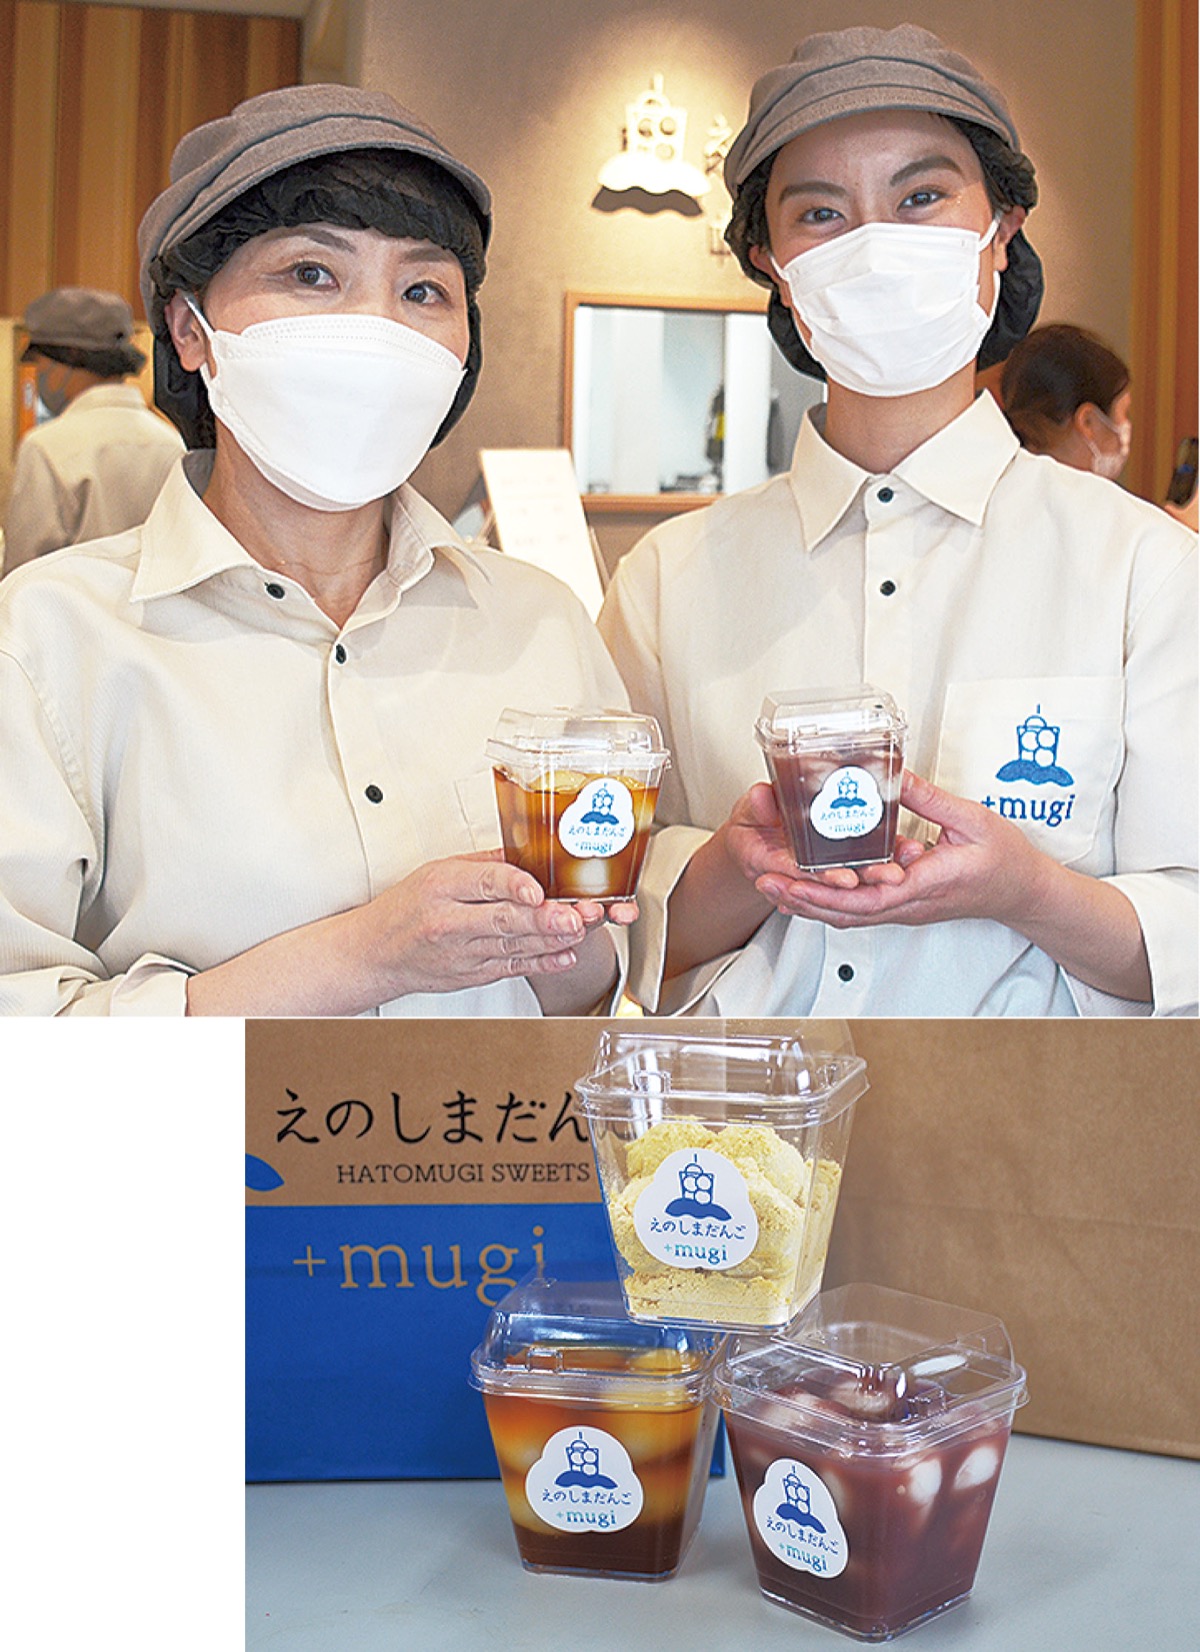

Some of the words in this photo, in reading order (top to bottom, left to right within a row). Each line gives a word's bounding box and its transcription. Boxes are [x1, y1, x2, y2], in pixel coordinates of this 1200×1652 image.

[981, 794, 1076, 828] +mugi
[276, 1087, 590, 1144] えのしまだん
[337, 1163, 485, 1184] HATOMUGI
[491, 1162, 591, 1183] SWEETS
[650, 1217, 747, 1240] えのしまだんご
[293, 1224, 546, 1308] +mugi
[664, 1243, 728, 1266] +mugi
[542, 1488, 632, 1505] えのしまだんご
[556, 1510, 617, 1528] +mugi
[766, 1515, 840, 1556] えのしまだんご
